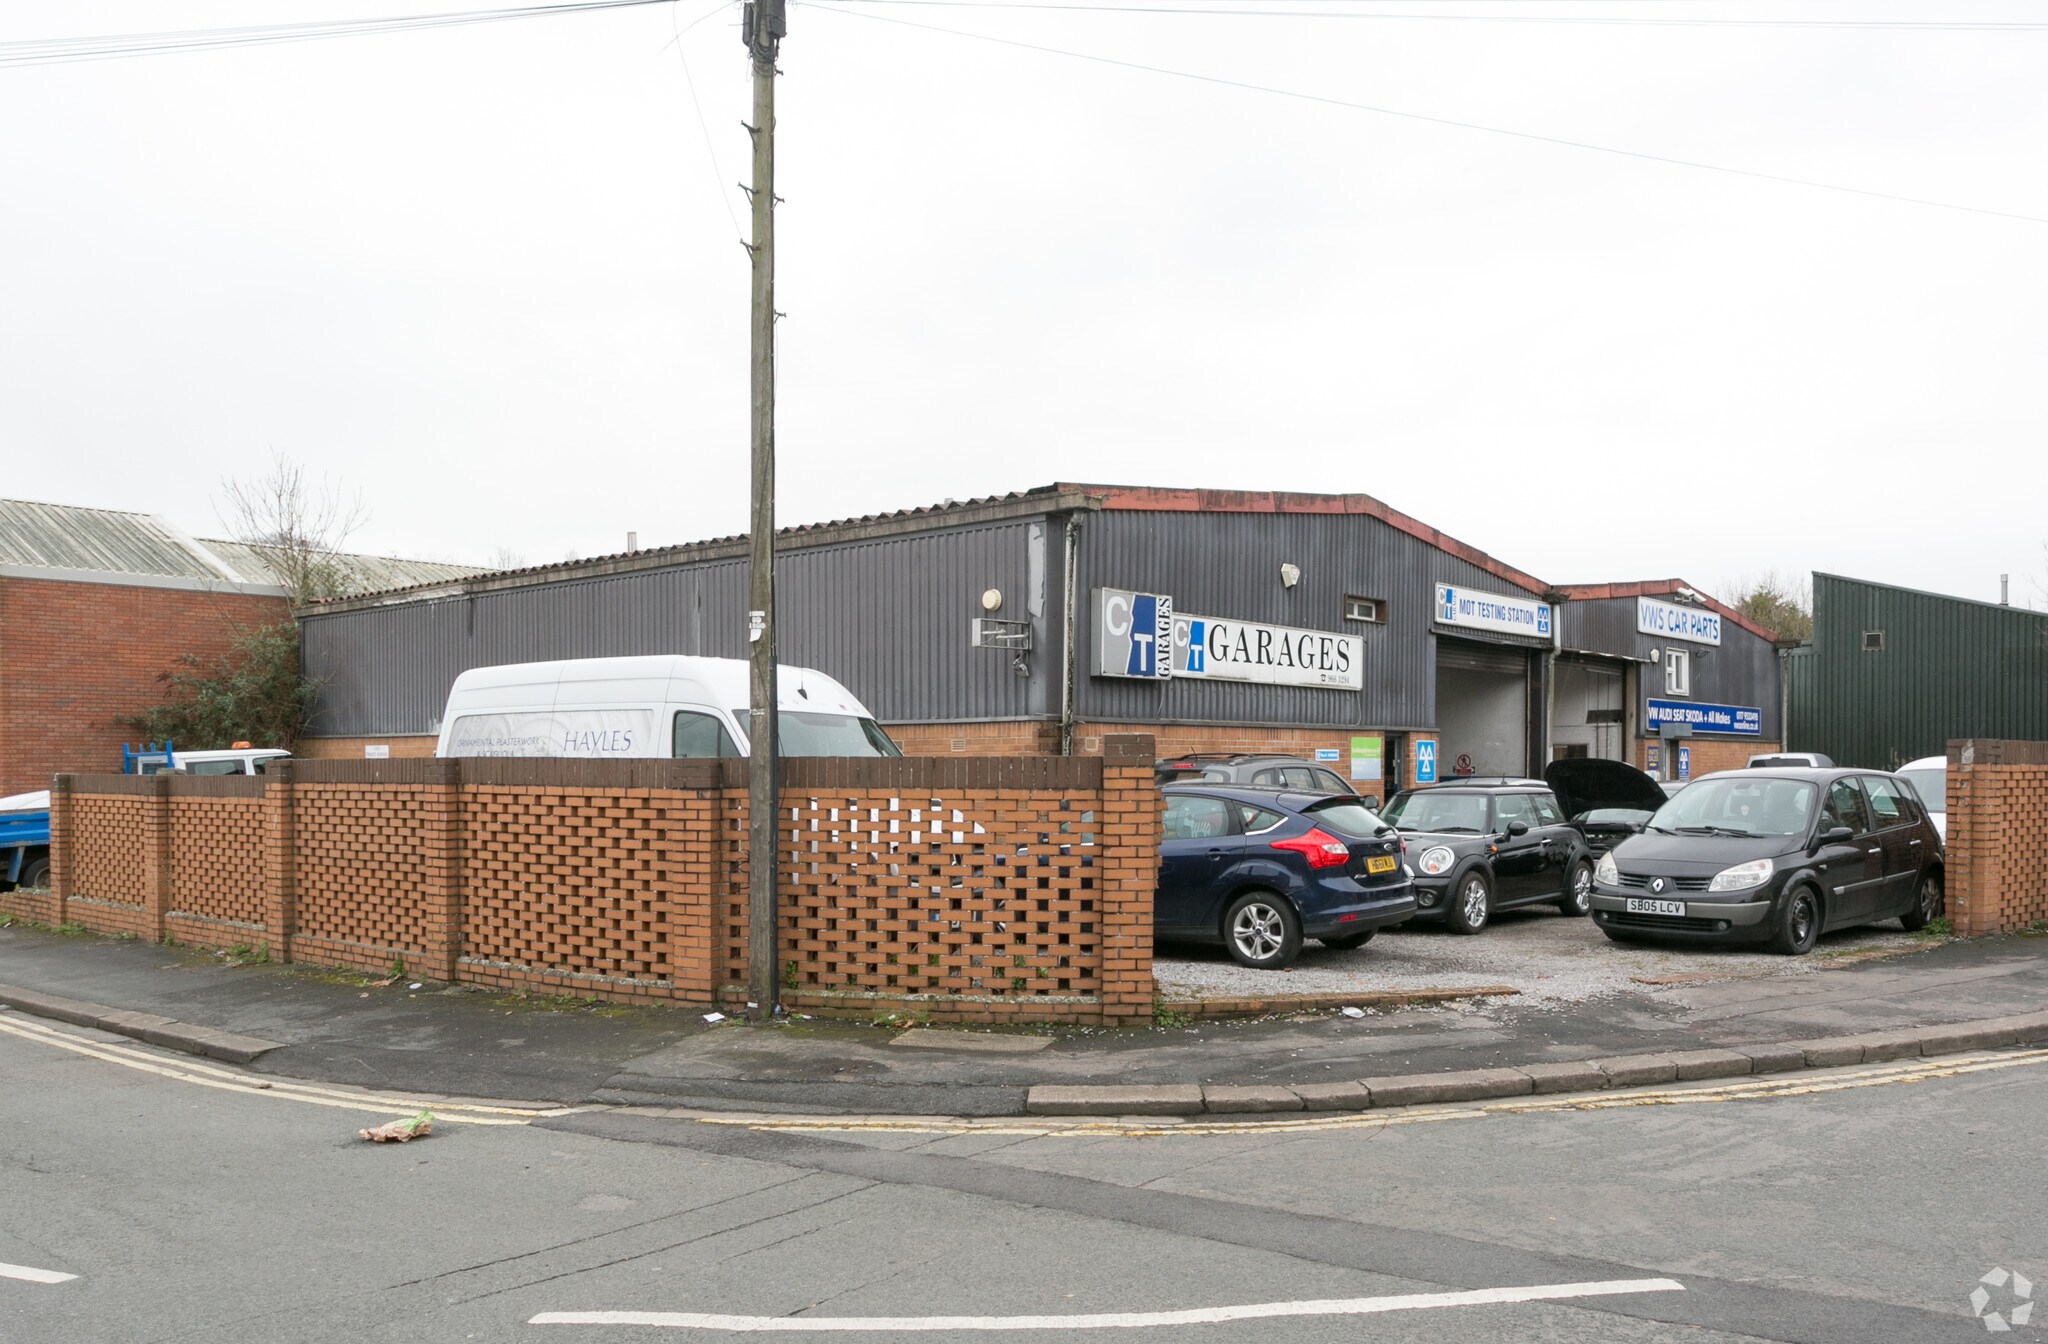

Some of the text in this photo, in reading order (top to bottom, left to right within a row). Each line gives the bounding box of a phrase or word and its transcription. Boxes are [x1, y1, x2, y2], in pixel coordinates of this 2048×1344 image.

[1459, 598, 1535, 626] MOT TESTING STATION
[1641, 603, 1719, 640] VWS CAR PARTS
[1158, 598, 1171, 677] GARAGES
[1208, 624, 1350, 673] GARAGES
[1648, 706, 1659, 720] VW
[1659, 707, 1673, 721] AUDI
[1673, 708, 1685, 722] SEAT
[1685, 709, 1704, 723] SKODA
[1715, 711, 1731, 725] Makes
[457, 736, 540, 748] ORNAMENTAL PLASTERWORK
[563, 730, 632, 756] HAYLES
[1631, 900, 1681, 914] SB05 LCV
